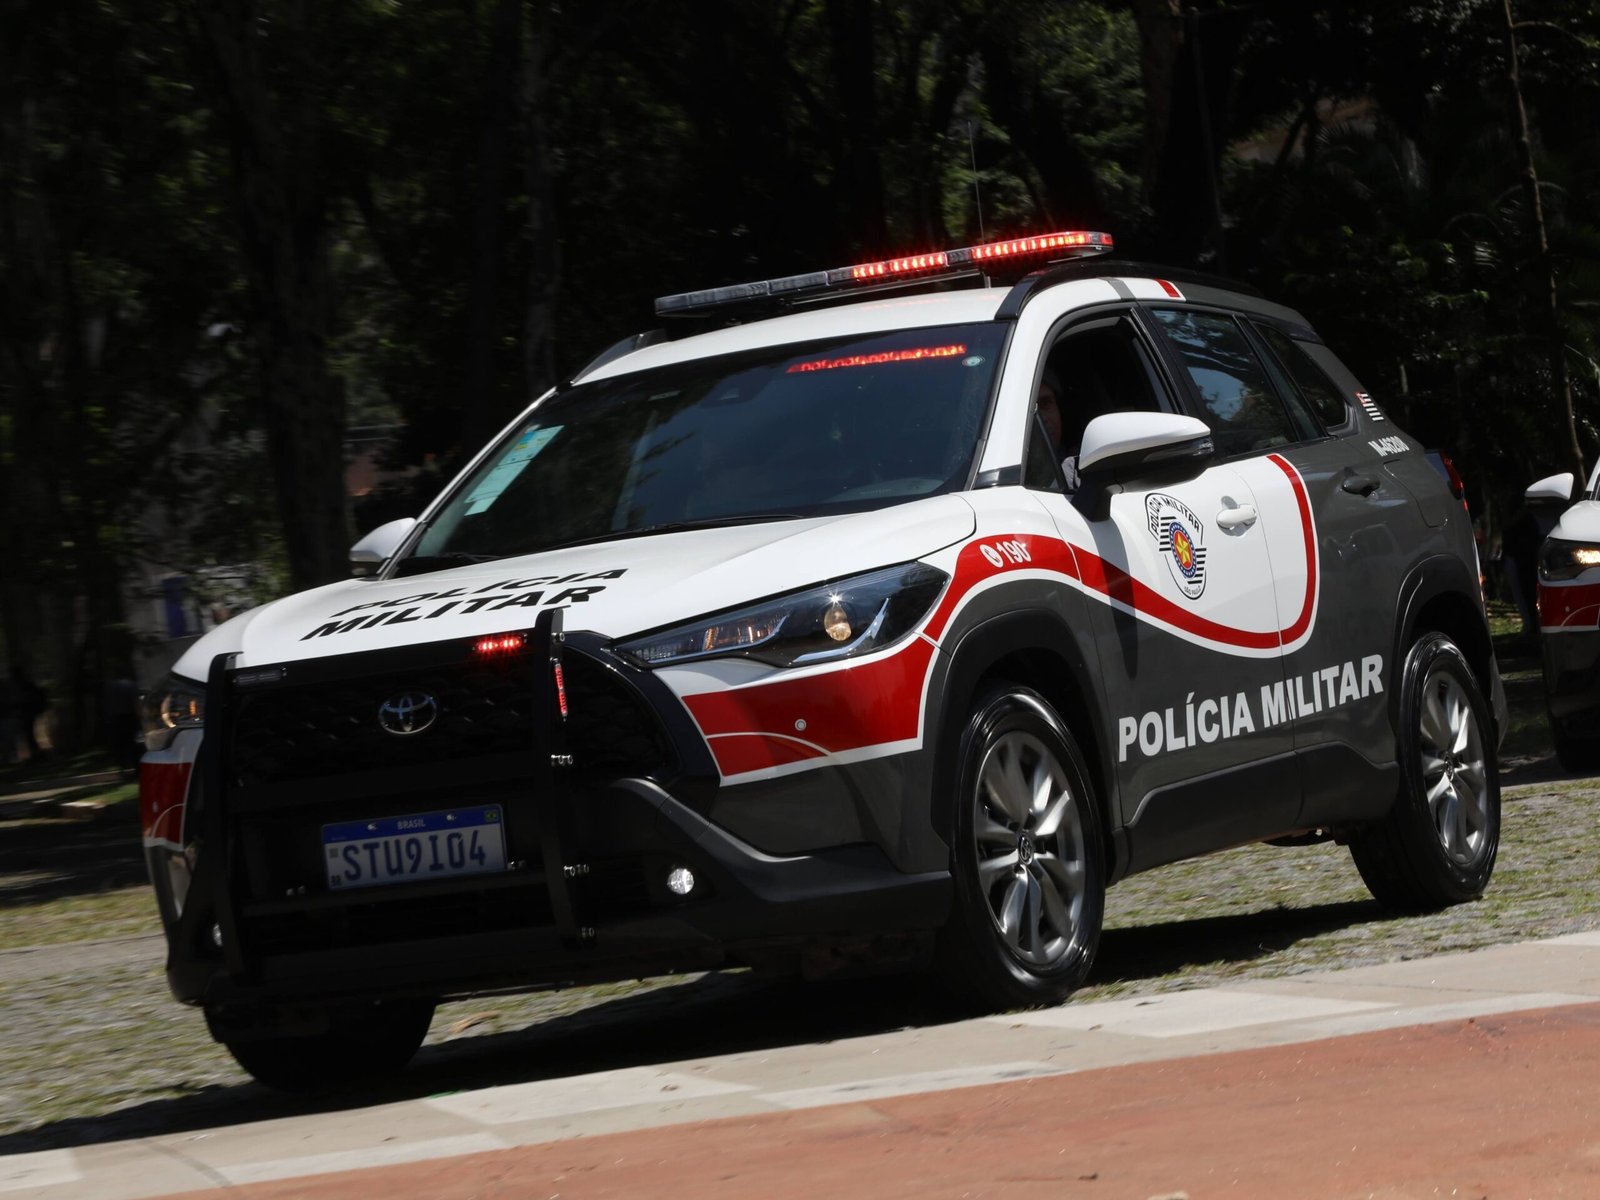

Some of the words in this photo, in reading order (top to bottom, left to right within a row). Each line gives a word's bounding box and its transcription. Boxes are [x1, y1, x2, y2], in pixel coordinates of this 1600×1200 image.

[1160, 496, 1200, 533] MILITAR
[995, 540, 1032, 564] 190
[299, 585, 607, 642] MILITAR
[1118, 691, 1256, 763] POLÍCIA
[1260, 653, 1385, 729] MILITAR
[396, 817, 427, 831] BRASIL
[342, 829, 486, 882] STU9I04
